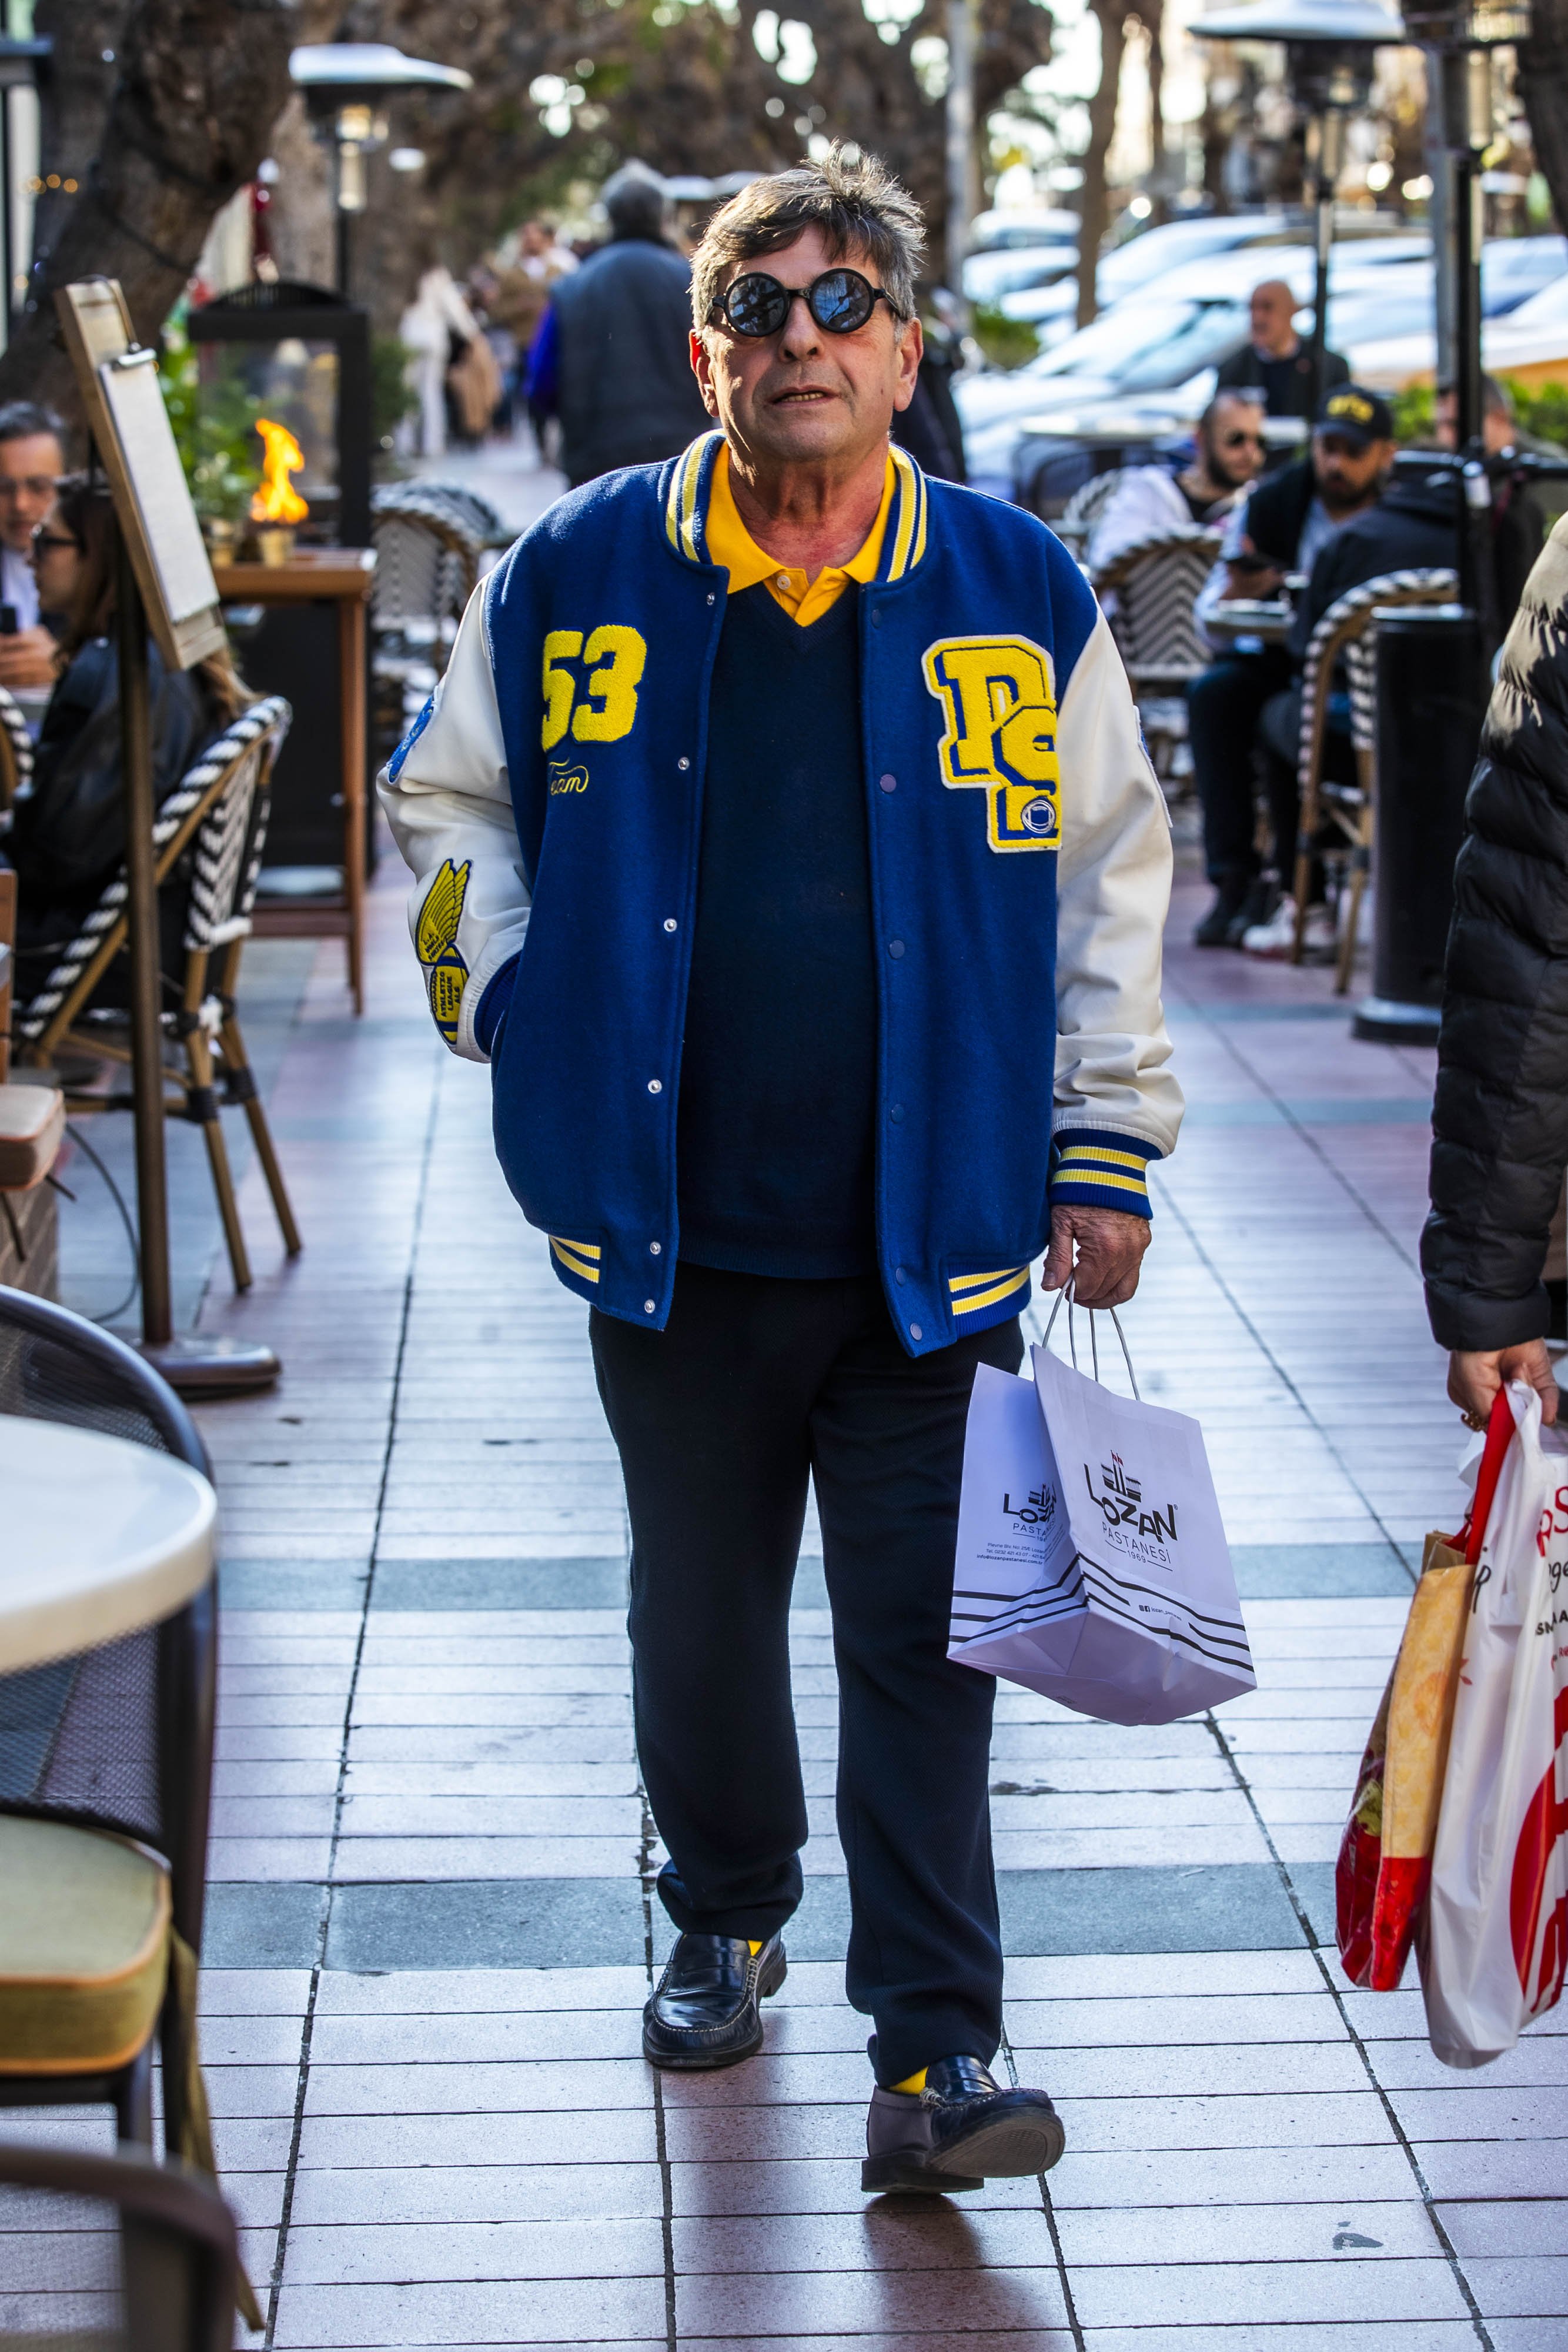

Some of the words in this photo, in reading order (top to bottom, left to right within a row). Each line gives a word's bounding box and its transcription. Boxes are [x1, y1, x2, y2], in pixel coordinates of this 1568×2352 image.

[1084, 1463, 1178, 1544] LOZAN
[1102, 1521, 1172, 1564] PASTANESİ
[1127, 1550, 1146, 1563] 1969
